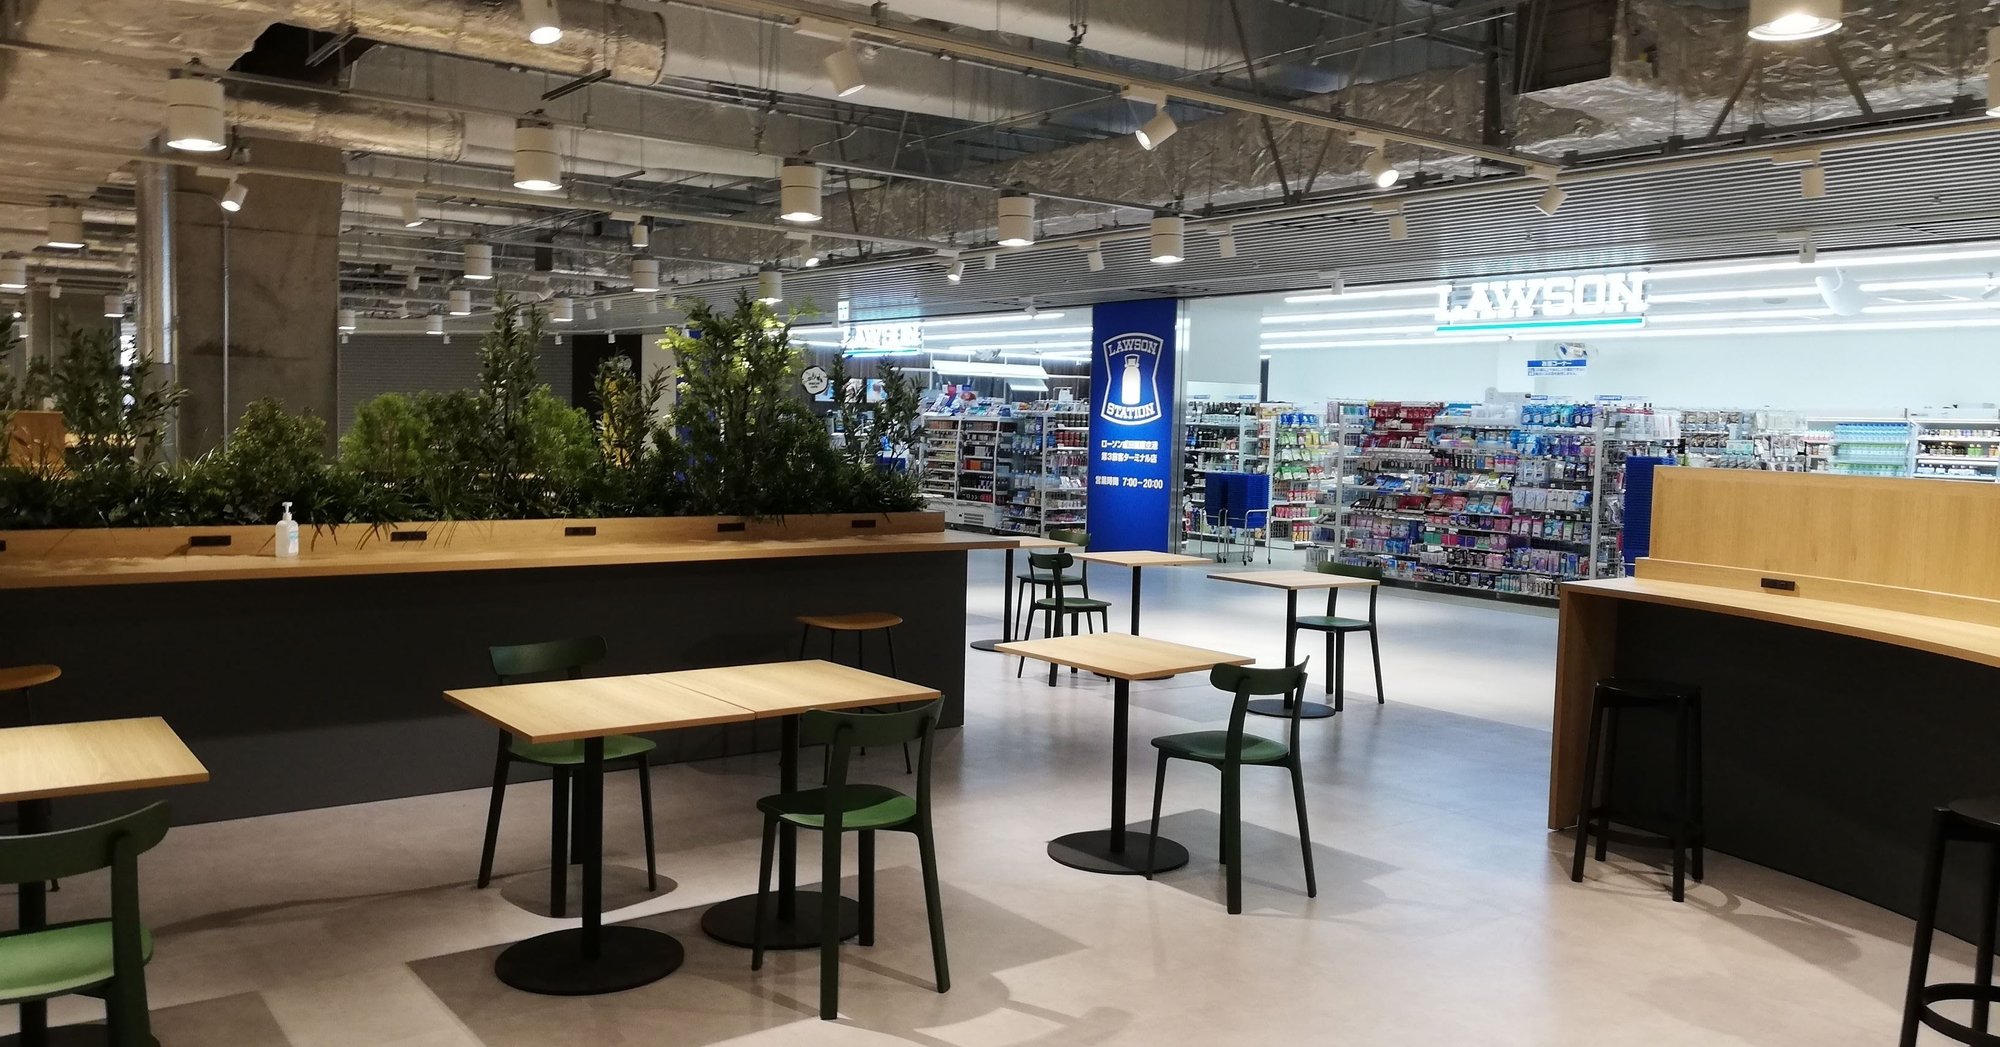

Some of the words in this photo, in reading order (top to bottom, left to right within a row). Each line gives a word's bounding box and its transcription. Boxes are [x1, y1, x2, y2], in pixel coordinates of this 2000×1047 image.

[1435, 272, 1650, 321] LAWSON
[1108, 339, 1158, 356] LAWSON
[1106, 402, 1155, 419] STATION
